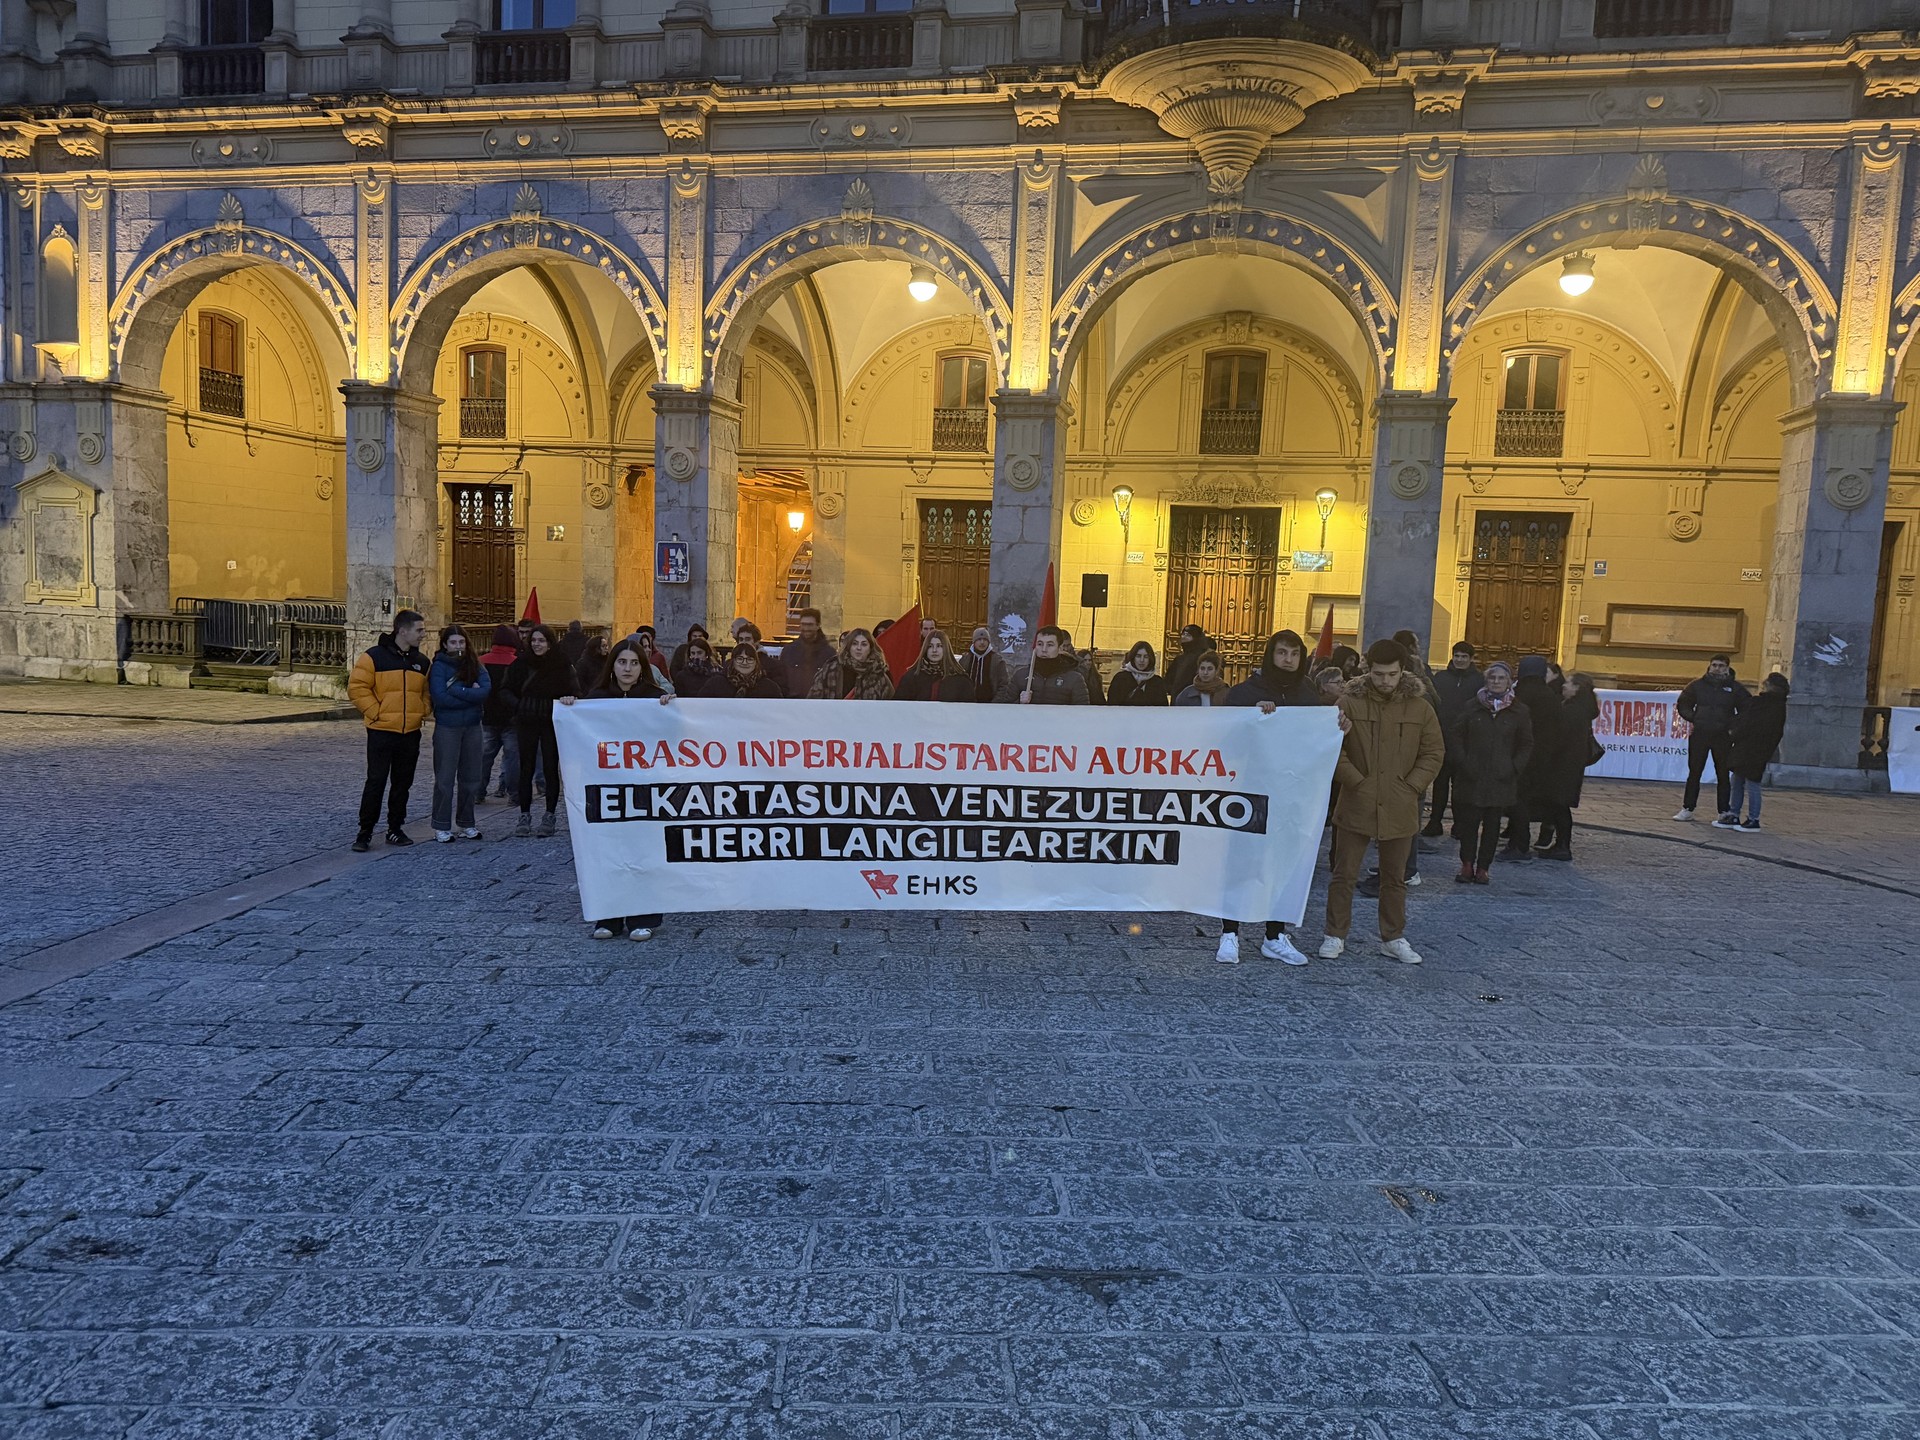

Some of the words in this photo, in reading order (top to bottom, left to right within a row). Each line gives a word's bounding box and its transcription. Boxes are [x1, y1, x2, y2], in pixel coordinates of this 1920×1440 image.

[597, 739, 727, 769] ERASO
[738, 739, 1077, 773] INPERIALISTAREN
[1087, 746, 1237, 782] AURKA,
[600, 784, 916, 819] ELKARTASUNA
[930, 786, 1254, 828] VENEZUELAKO
[682, 826, 804, 859] HERRI
[820, 827, 1166, 861] LANGILEAREKIN
[906, 874, 978, 896] EHKS
